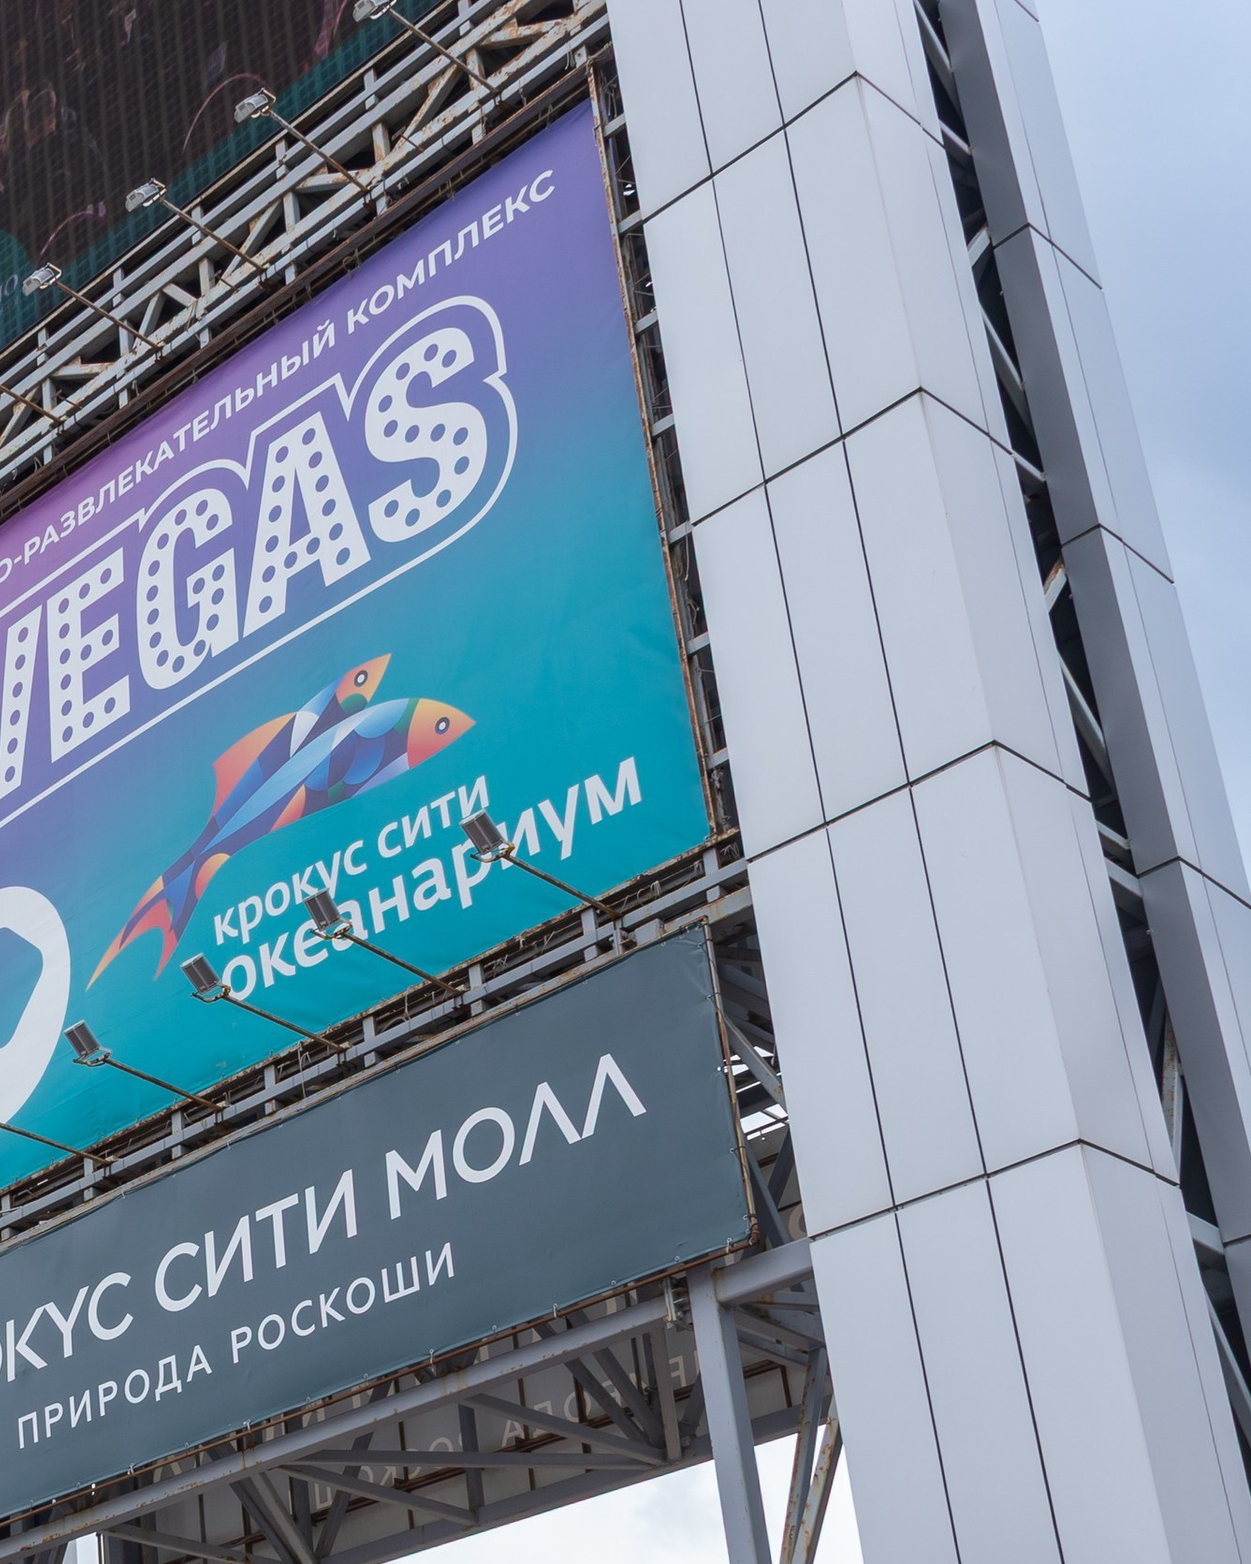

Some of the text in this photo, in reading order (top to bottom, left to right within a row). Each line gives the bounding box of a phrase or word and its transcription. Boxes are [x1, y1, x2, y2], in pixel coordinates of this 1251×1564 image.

[346, 169, 556, 337] КОМПЛЕКС
[213, 775, 490, 946] крокус сити
[154, 1169, 358, 1312] СИТИ
[386, 1052, 647, 1220] МОЛЛ
[16, 1242, 457, 1451] ПРИРОДА РОСКОШИ
